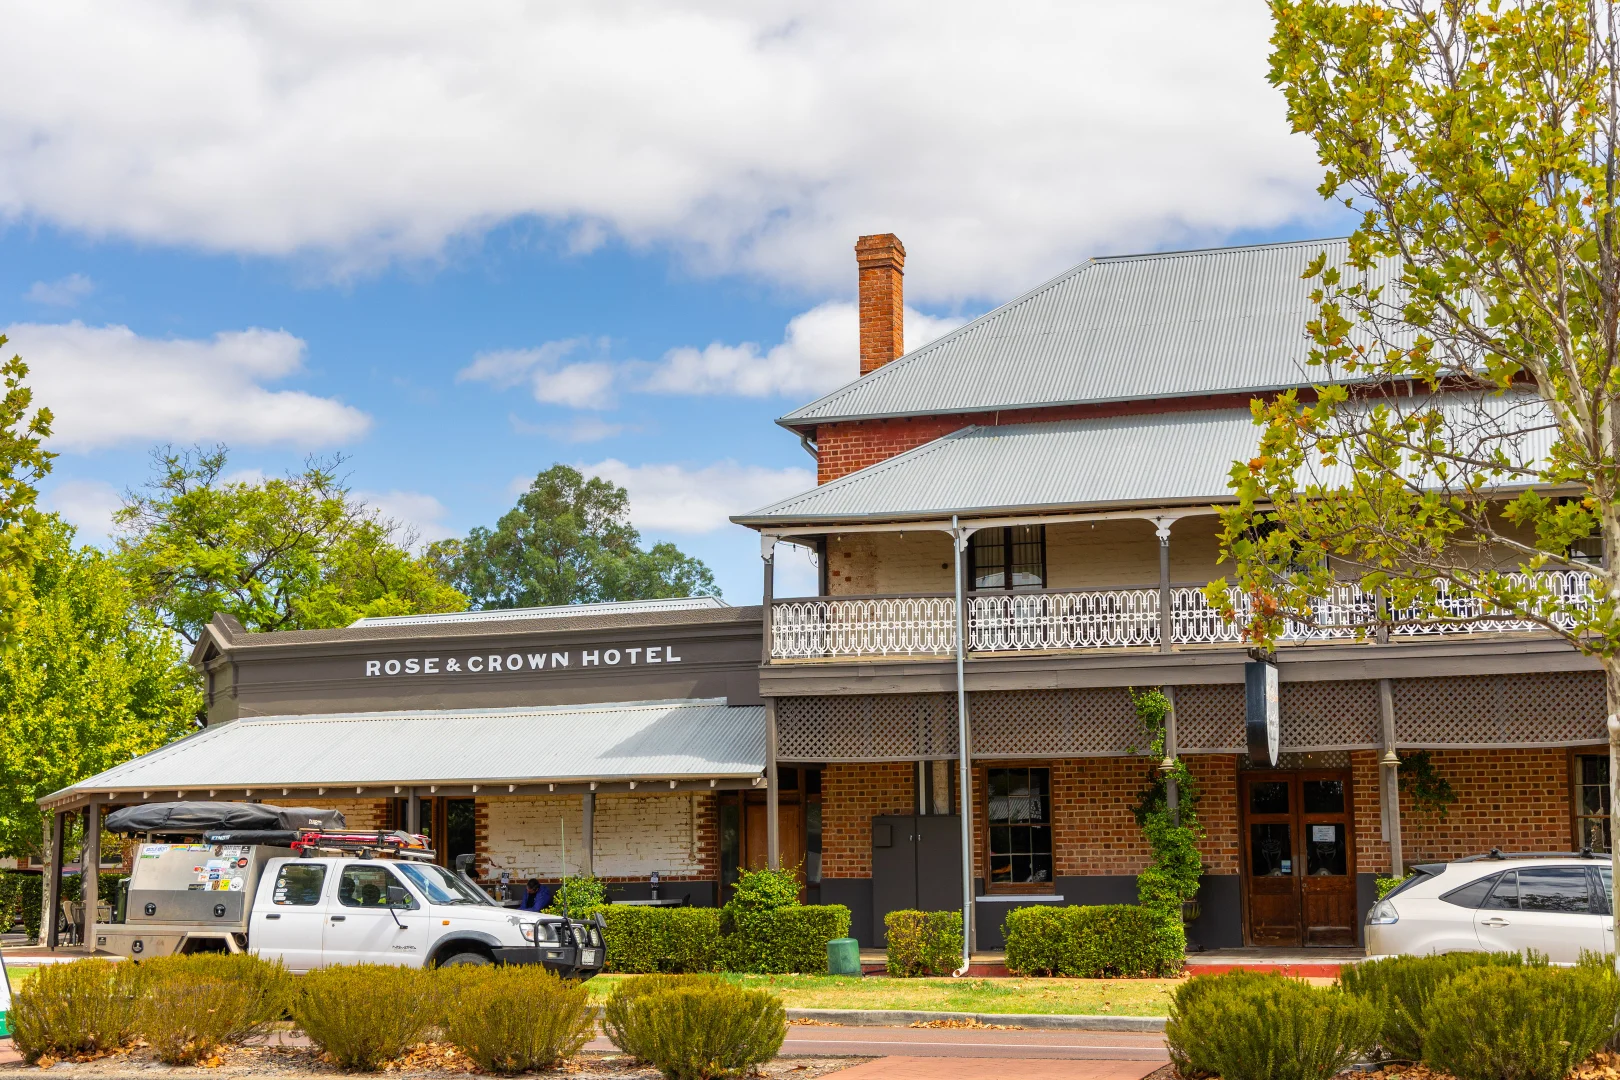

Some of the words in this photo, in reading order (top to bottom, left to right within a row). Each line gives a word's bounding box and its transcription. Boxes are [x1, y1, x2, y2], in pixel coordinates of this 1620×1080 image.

[366, 657, 440, 677] ROSE
[446, 657, 462, 672] &
[467, 651, 569, 672] CROWN
[582, 645, 682, 667] HOTEL
